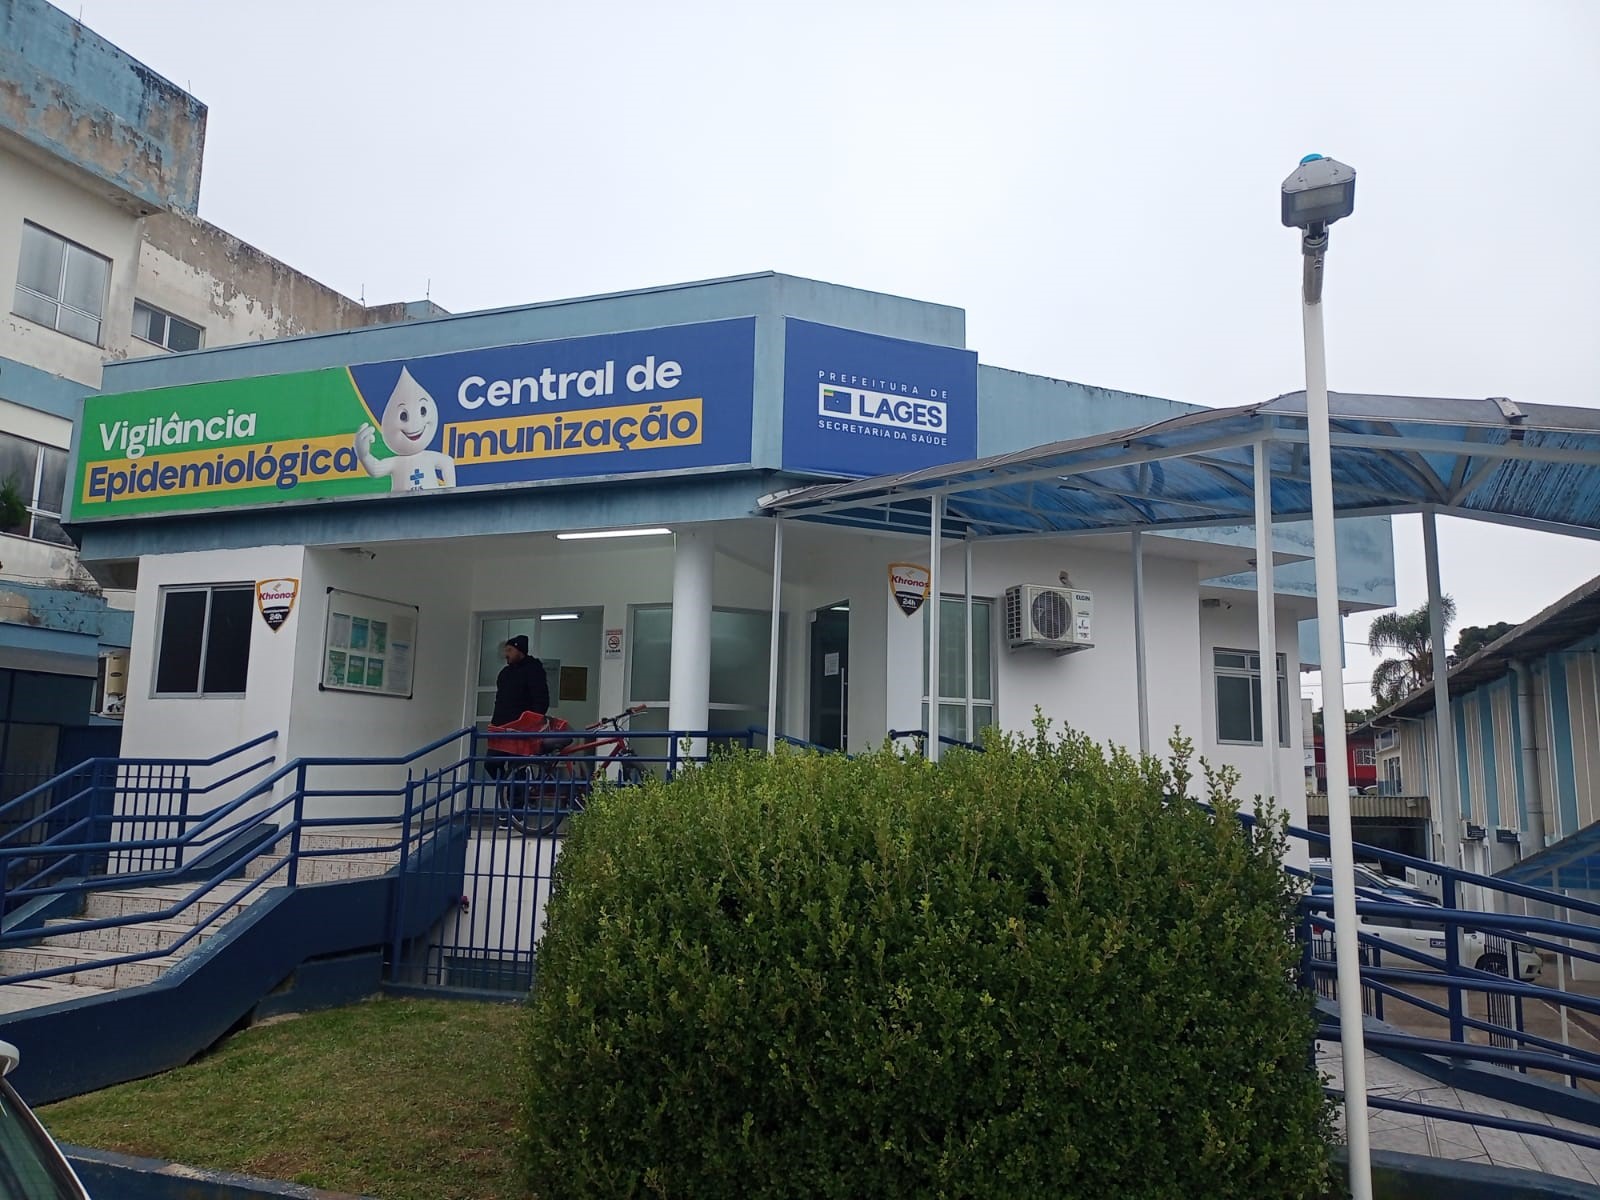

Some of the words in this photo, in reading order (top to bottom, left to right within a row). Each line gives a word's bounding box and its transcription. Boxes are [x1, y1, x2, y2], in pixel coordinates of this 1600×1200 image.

[457, 360, 615, 410] Central
[625, 355, 683, 392] de
[818, 370, 919, 395] PREFEITURA
[930, 388, 948, 399] DE
[859, 394, 943, 428] LAGES
[99, 408, 257, 460] Vigilância
[449, 405, 698, 459] Imunização
[818, 420, 891, 438] SECRETARIA
[894, 431, 908, 441] DA
[911, 432, 948, 446] SAÚDE
[88, 444, 359, 503] Epidemiológica
[259, 592, 296, 600] Khronos
[891, 575, 929, 588] Khronos
[902, 598, 917, 606] 24h
[269, 613, 283, 621] 24h
